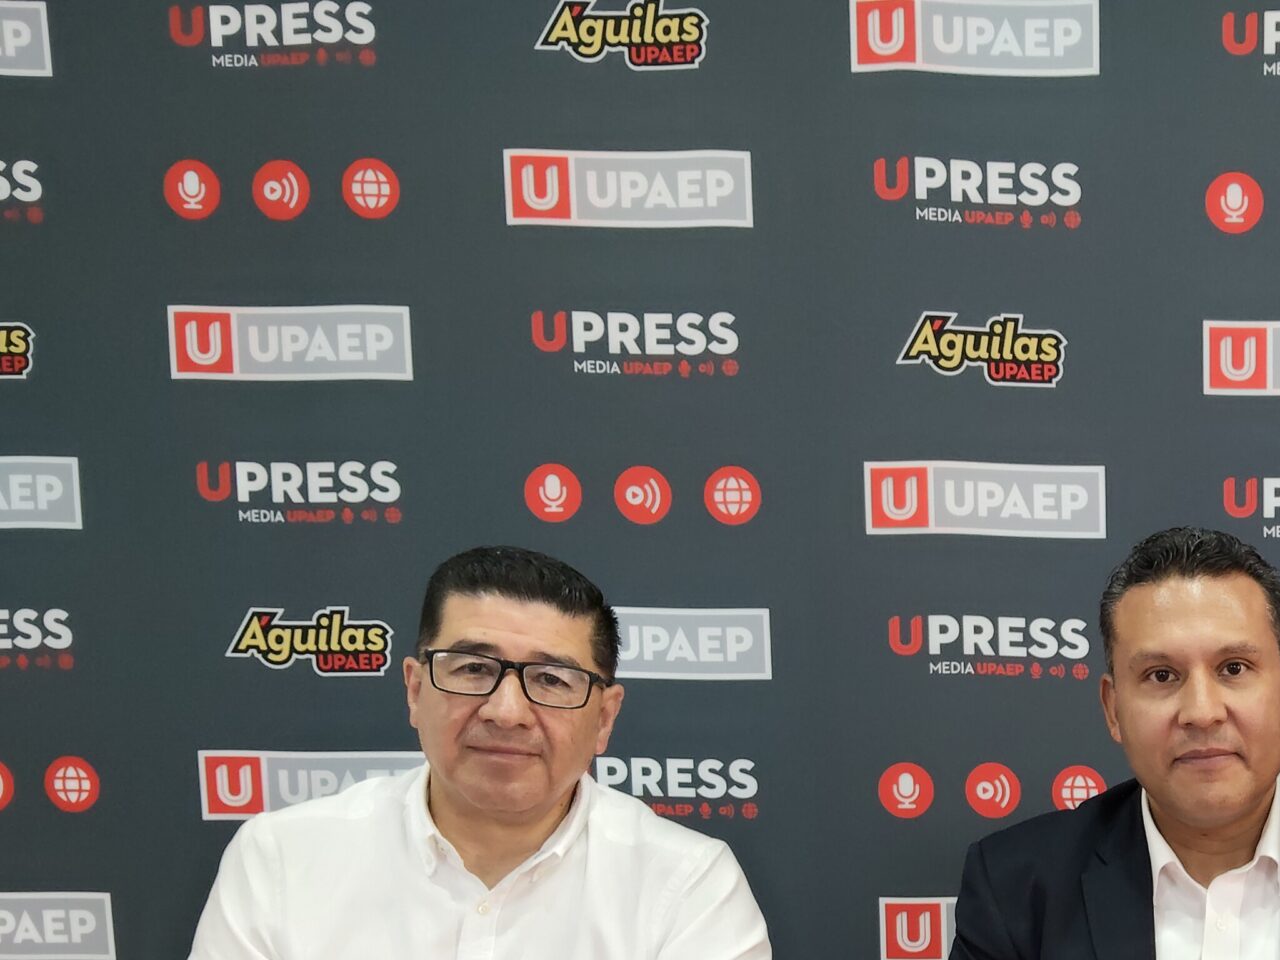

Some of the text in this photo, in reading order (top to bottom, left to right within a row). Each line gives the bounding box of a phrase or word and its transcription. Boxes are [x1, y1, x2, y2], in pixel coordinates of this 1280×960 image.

[170, 0, 376, 47] UPRESS
[548, 3, 700, 55] Águilas
[868, 8, 1081, 56] U UPAEP
[212, 54, 258, 67] MEDIA
[631, 45, 699, 64] UPAEP
[522, 165, 734, 210] U UPAEP
[874, 157, 1081, 206] UPRESS
[915, 208, 1014, 225] MEDIA UPAEP
[186, 321, 393, 365] U UPAEP
[531, 310, 739, 356] UPRESS
[909, 319, 1057, 368] Águilas
[574, 360, 672, 375] MEDIA UPAEP
[990, 362, 1056, 380] UPAEP
[1220, 337, 1256, 381] U
[197, 461, 400, 503] UPRESS
[882, 477, 1088, 520] U UPAEP
[238, 509, 284, 523] MEDIA
[238, 613, 385, 662] Águilas
[888, 615, 1089, 659] UPRESS
[318, 654, 384, 670] UPAEP
[929, 662, 1025, 676] MEDIA UPAEP
[216, 765, 252, 806] U
[596, 757, 758, 799] PRESS
[0, 910, 96, 944] PAEP
[896, 912, 930, 952] U
